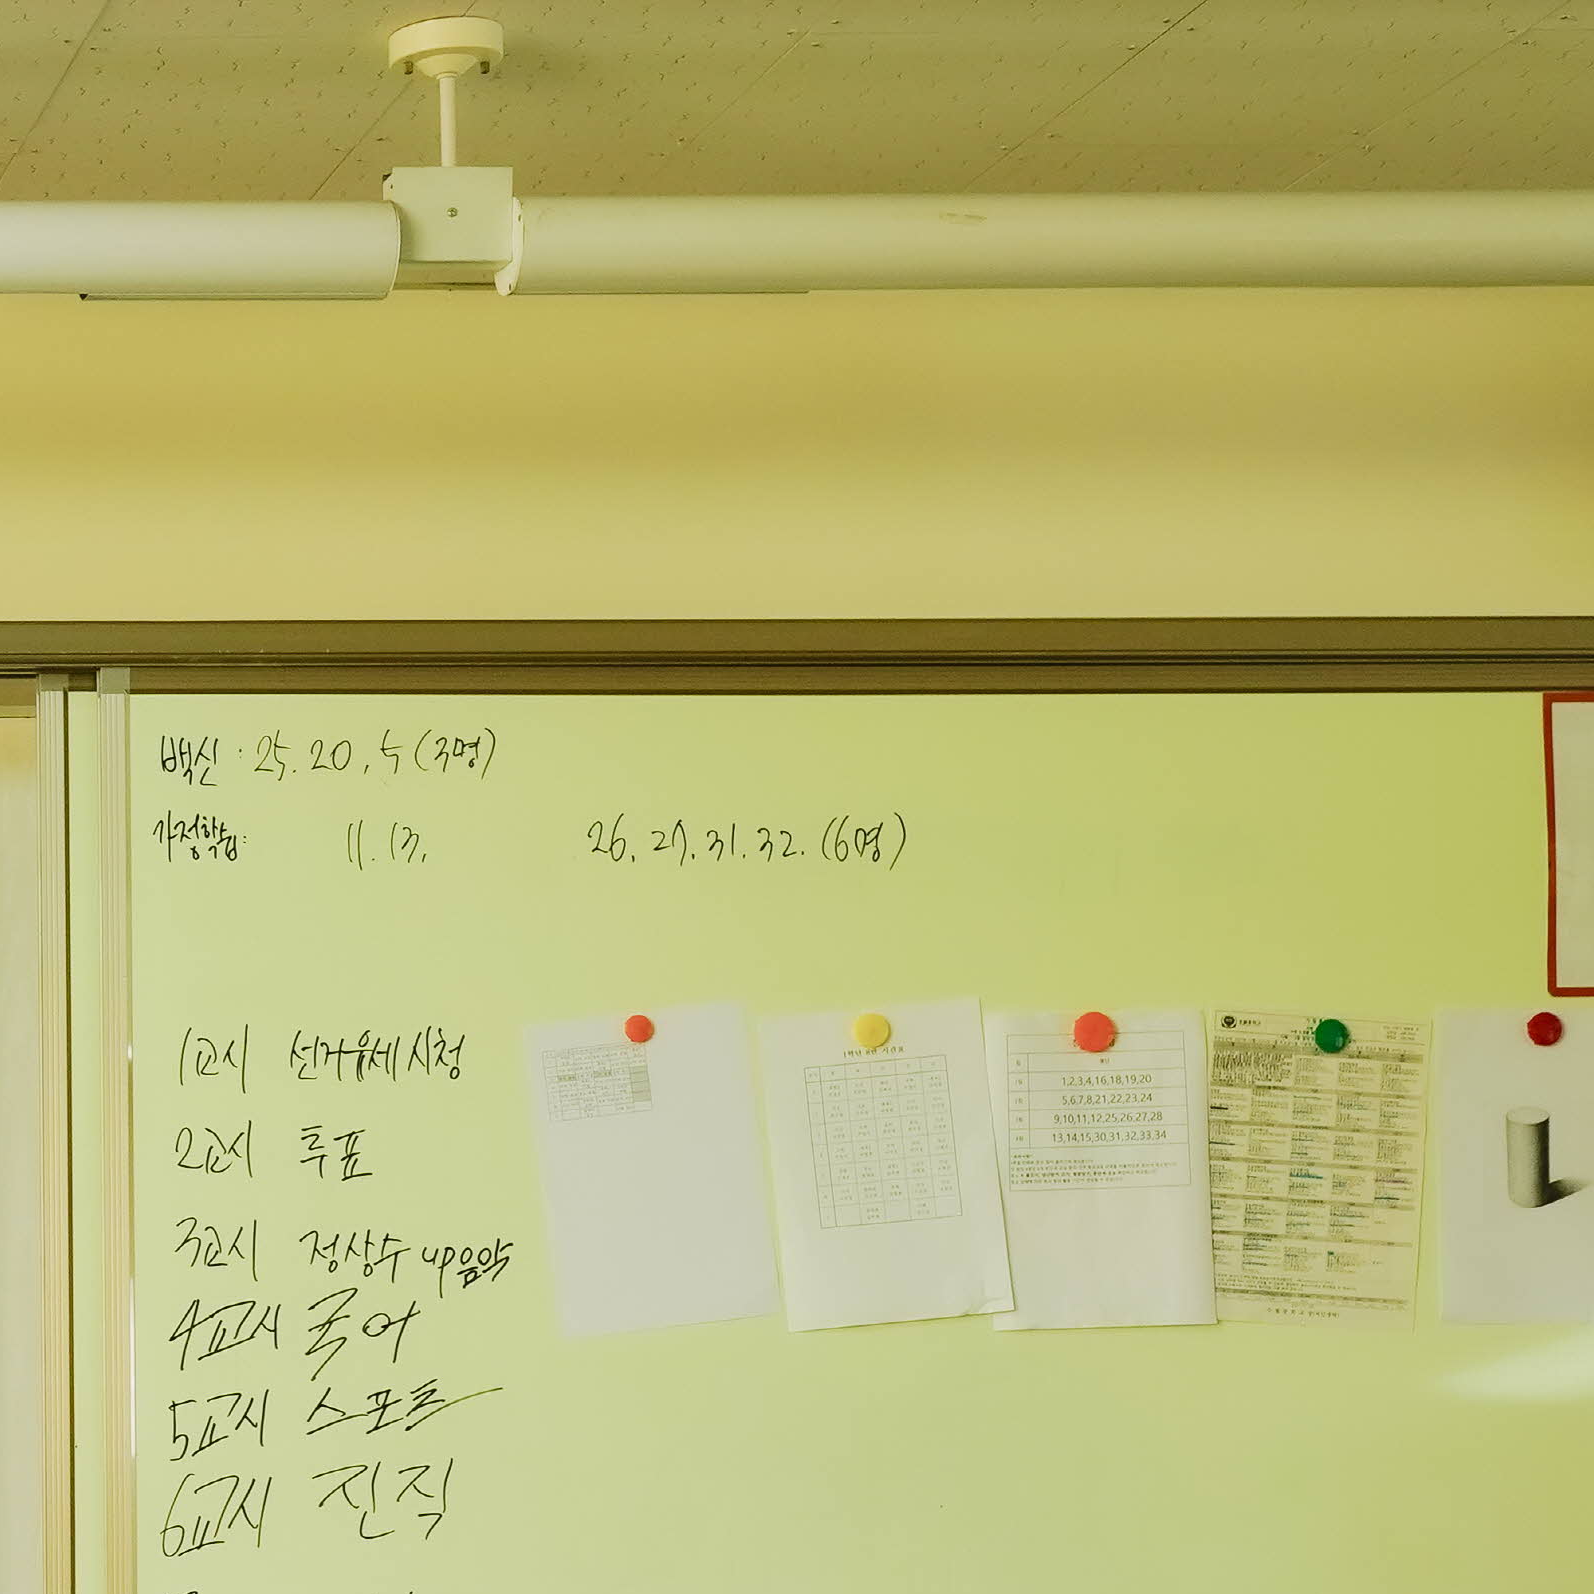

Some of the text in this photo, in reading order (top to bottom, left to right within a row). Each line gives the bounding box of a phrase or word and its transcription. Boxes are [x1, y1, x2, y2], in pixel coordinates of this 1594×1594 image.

[179, 1023, 249, 1094] 1교시
[175, 1119, 374, 1182] 2교시 투표
[174, 1216, 259, 1282] 3교시
[168, 1287, 422, 1382] 4교시 국어
[168, 1388, 270, 1462] 5교시
[159, 1472, 273, 1558] 6교시
